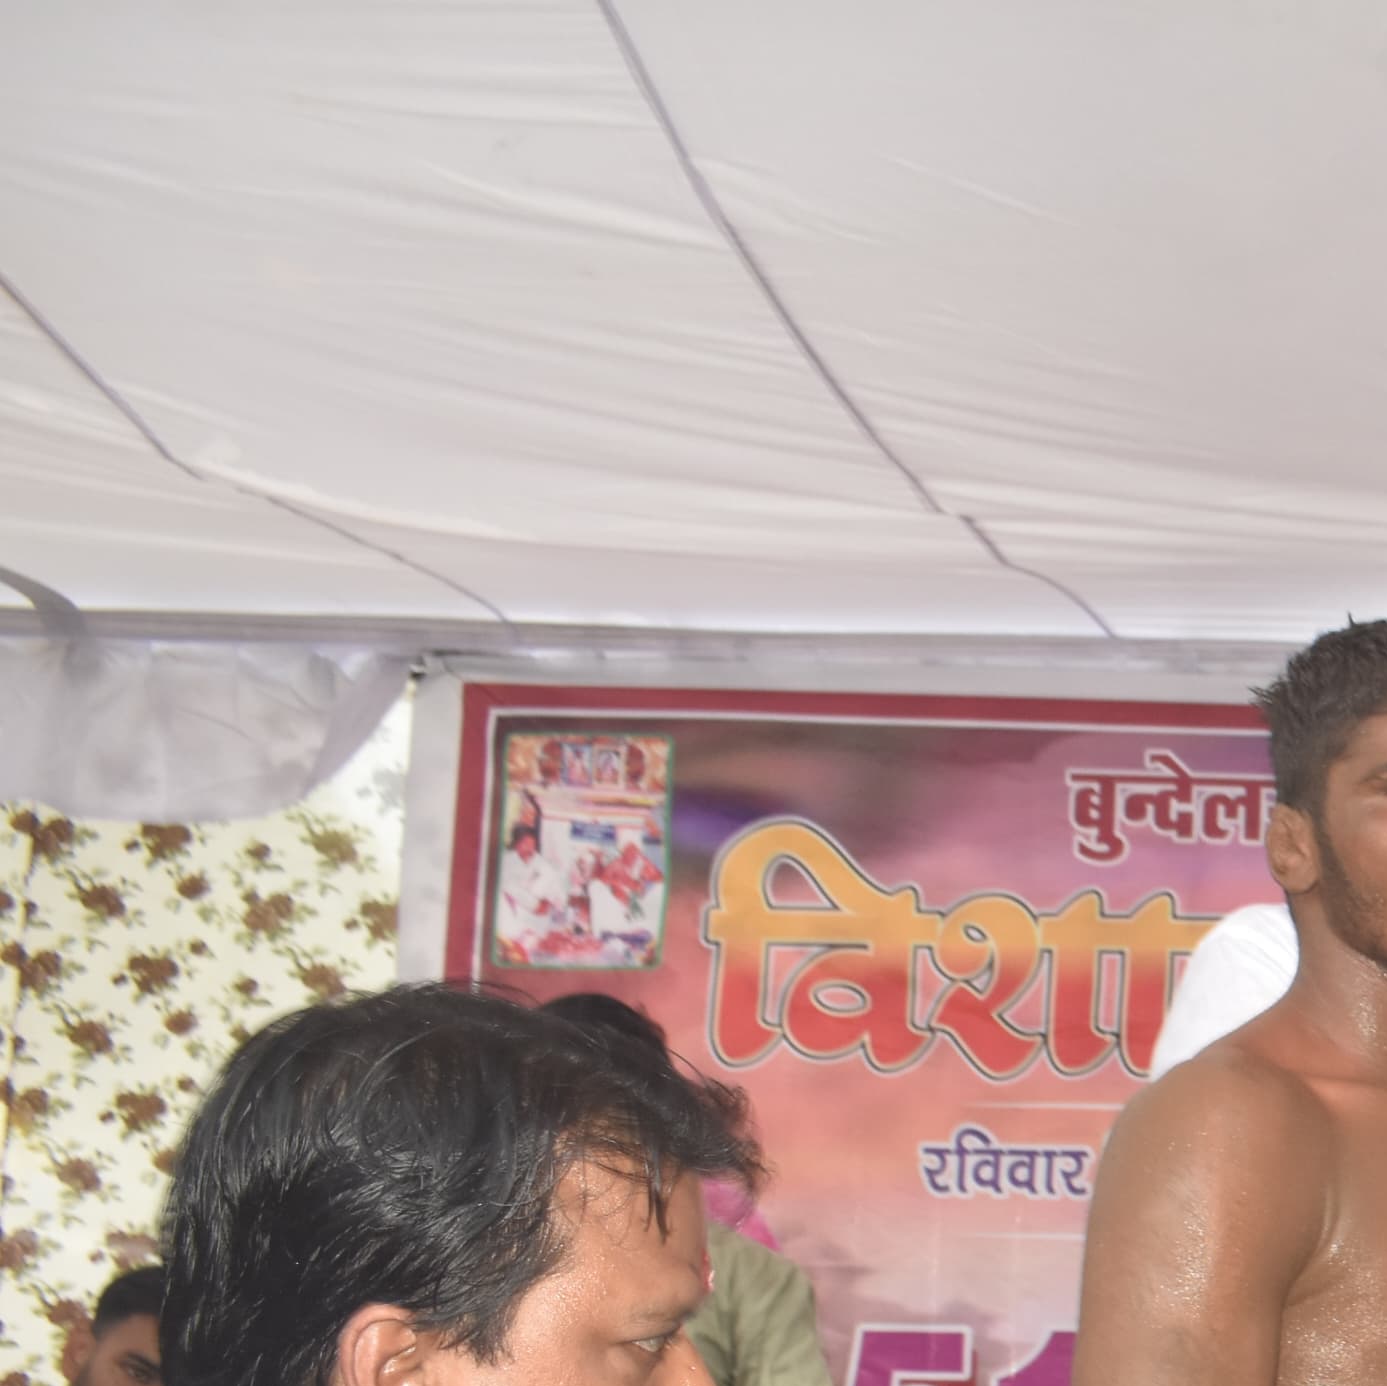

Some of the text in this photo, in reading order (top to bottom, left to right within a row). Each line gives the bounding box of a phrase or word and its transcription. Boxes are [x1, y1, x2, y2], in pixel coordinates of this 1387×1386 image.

[1067, 749, 1276, 866] बुन्देल
[705, 817, 1226, 1082] विशा
[920, 1125, 1092, 1197] रविवार
